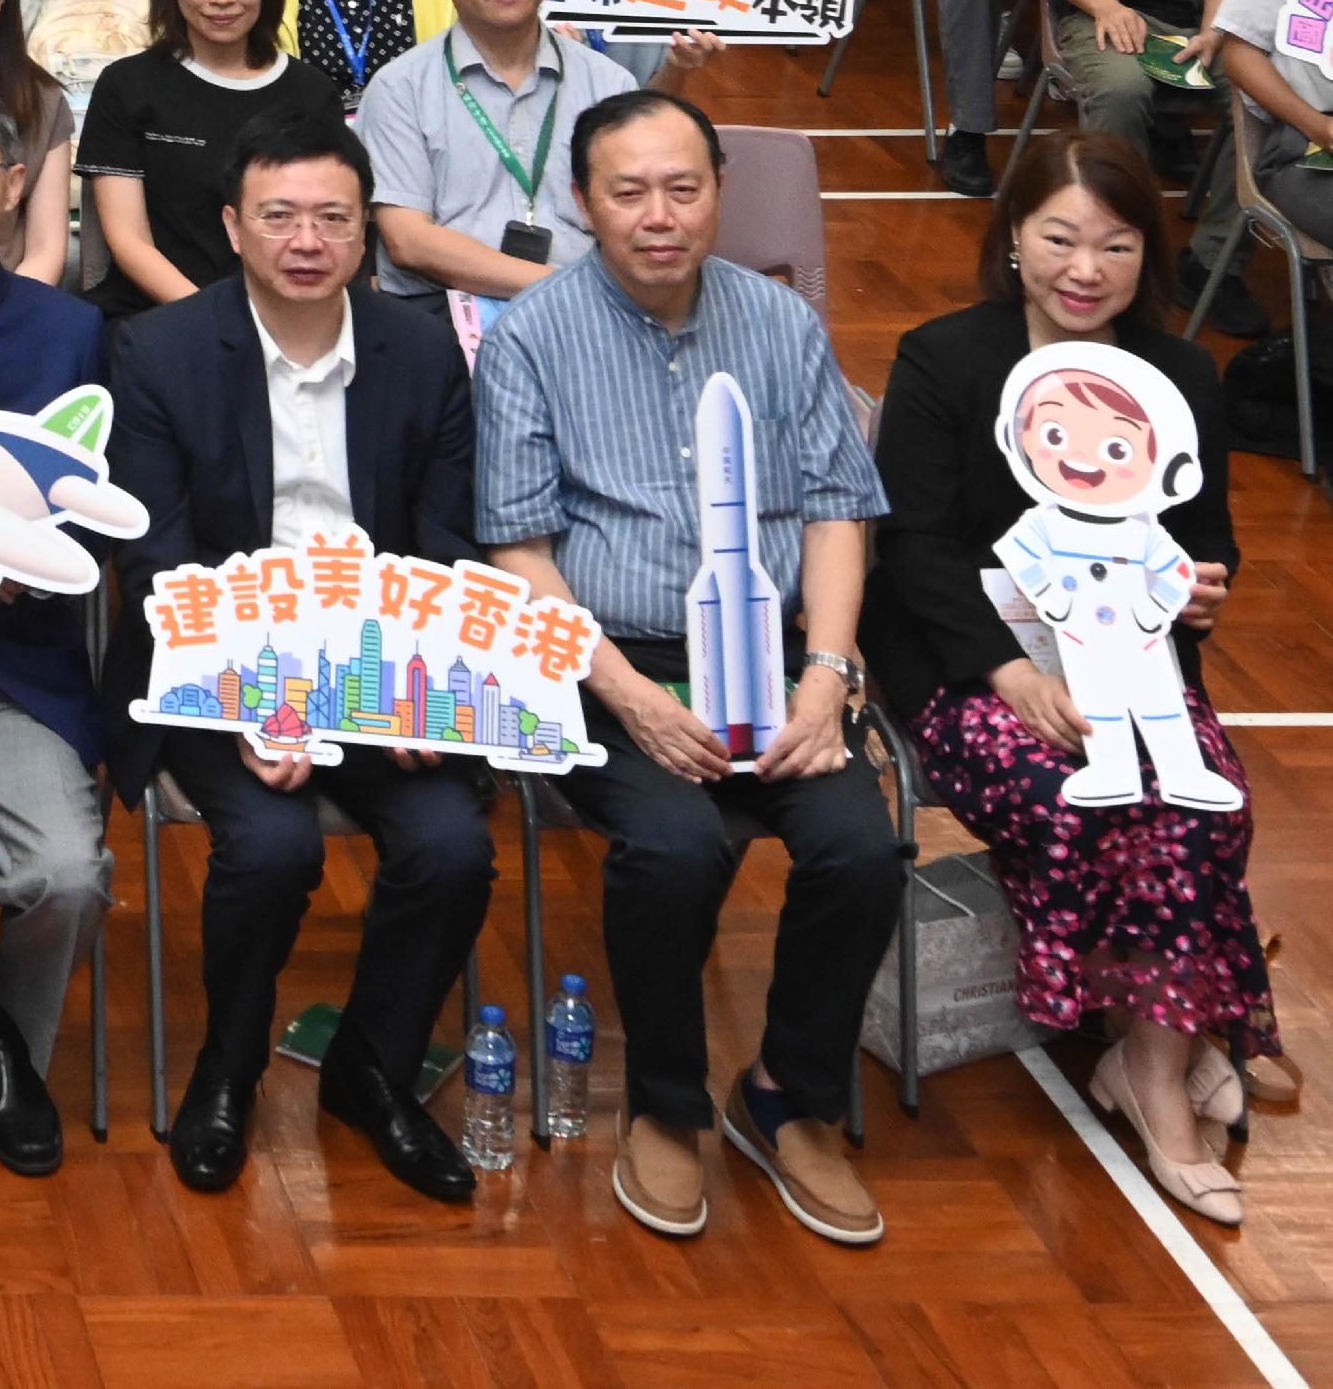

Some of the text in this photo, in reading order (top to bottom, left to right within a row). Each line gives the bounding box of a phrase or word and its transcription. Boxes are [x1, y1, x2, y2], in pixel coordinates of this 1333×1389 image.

[155, 531, 594, 685] 建設美好香港
